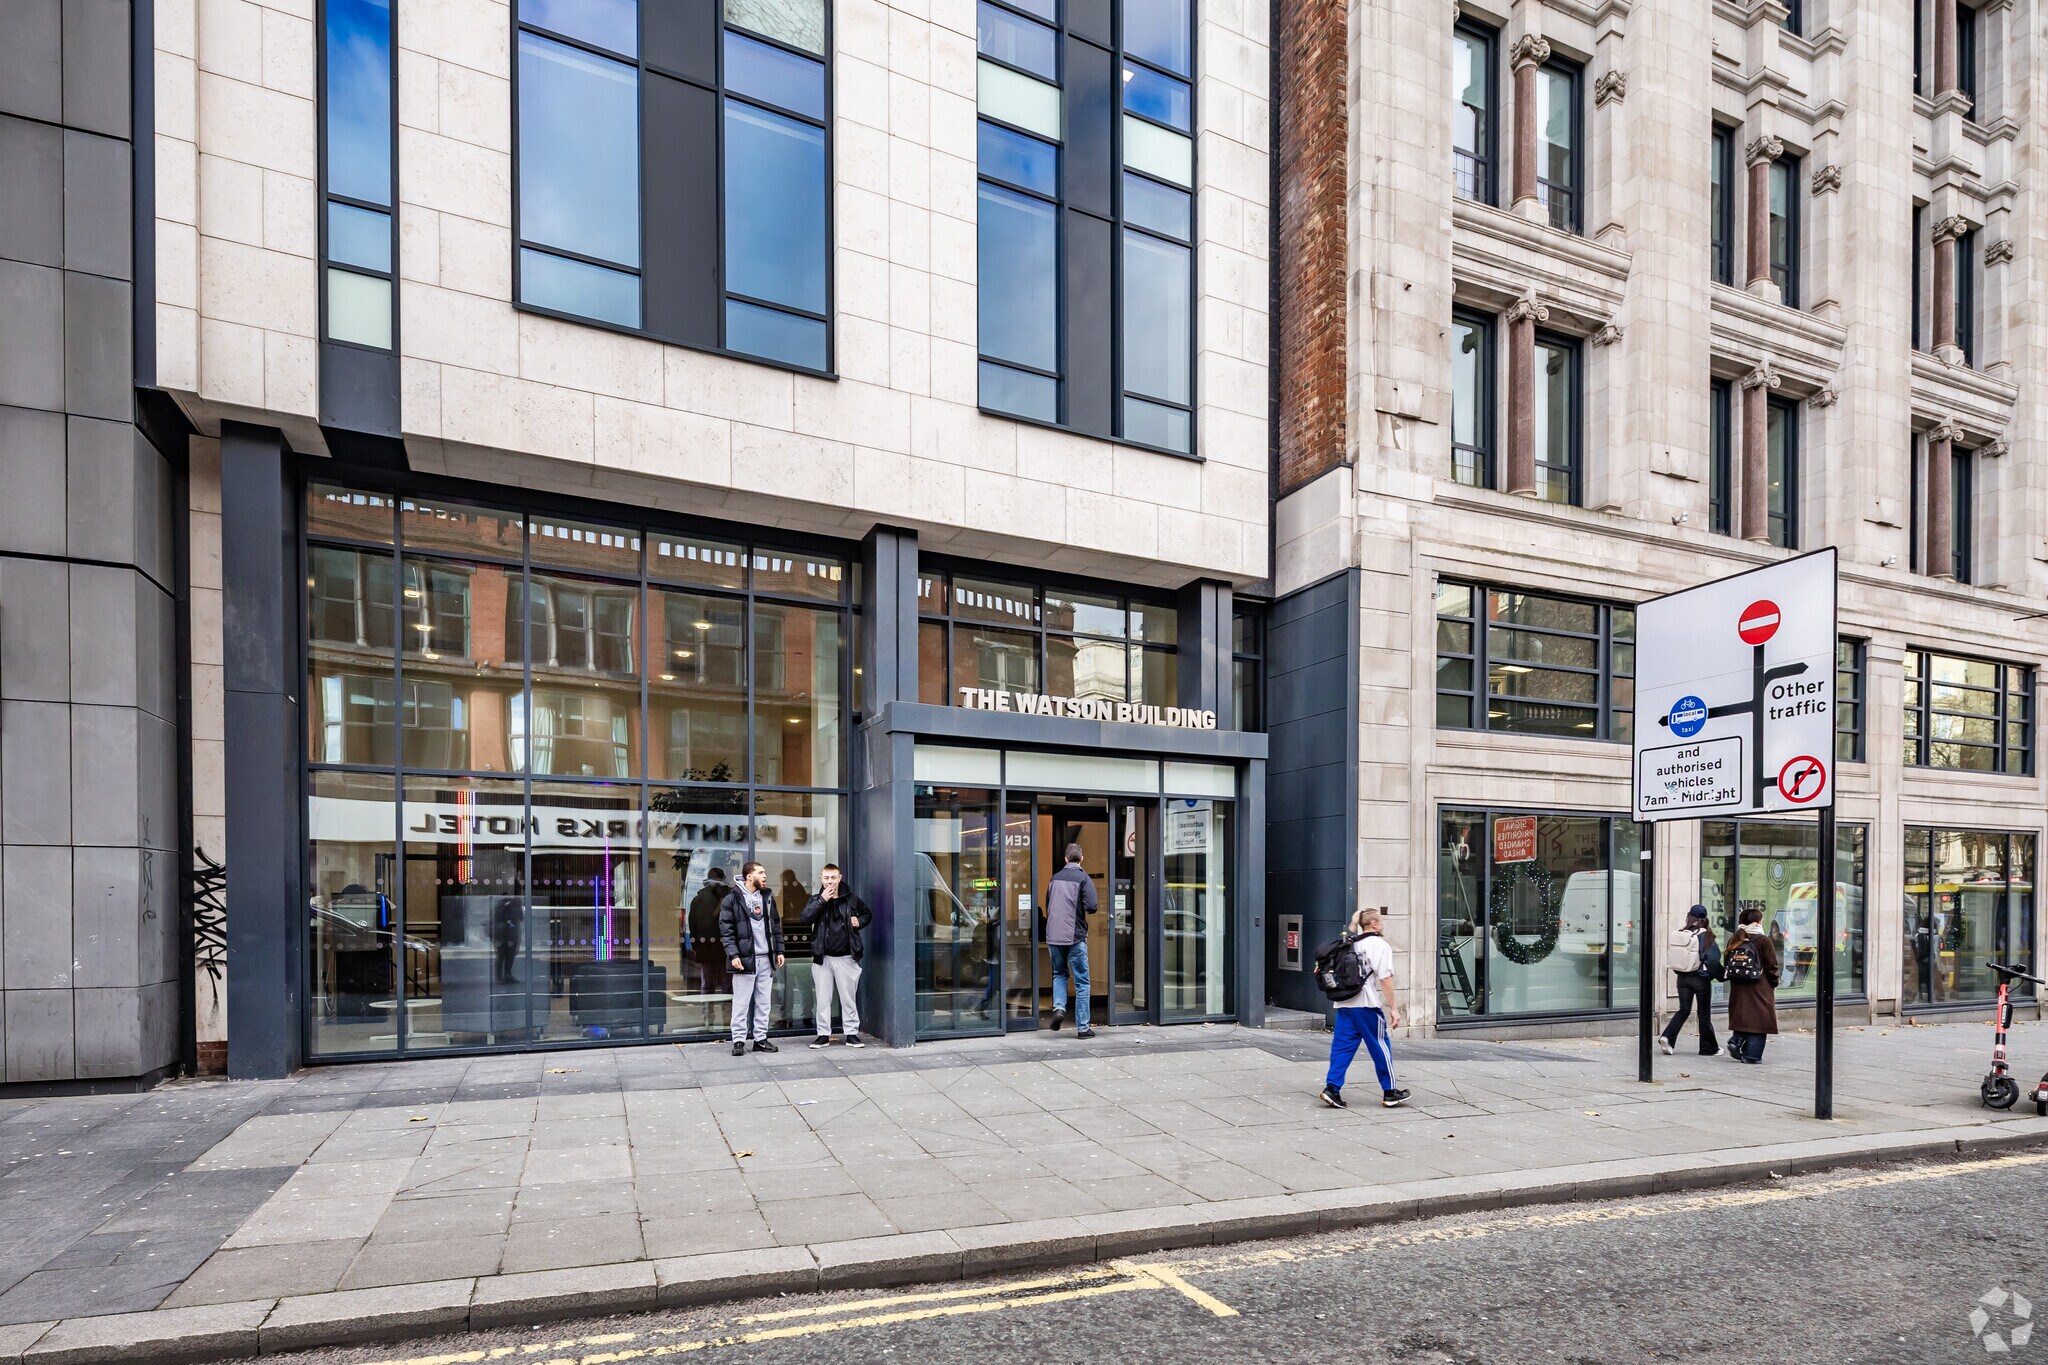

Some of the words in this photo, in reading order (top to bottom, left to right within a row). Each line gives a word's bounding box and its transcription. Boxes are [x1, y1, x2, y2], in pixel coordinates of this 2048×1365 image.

[1772, 681, 1824, 699] Other
[959, 687, 1010, 712] THE
[1014, 693, 1113, 721] WATSON
[1116, 702, 1216, 730] BUILDING
[1769, 699, 1826, 720] traffic
[1677, 746, 1700, 759] and
[1656, 758, 1722, 776] authorised
[1664, 776, 1714, 788] vehicles
[1644, 796, 1668, 806] 7am
